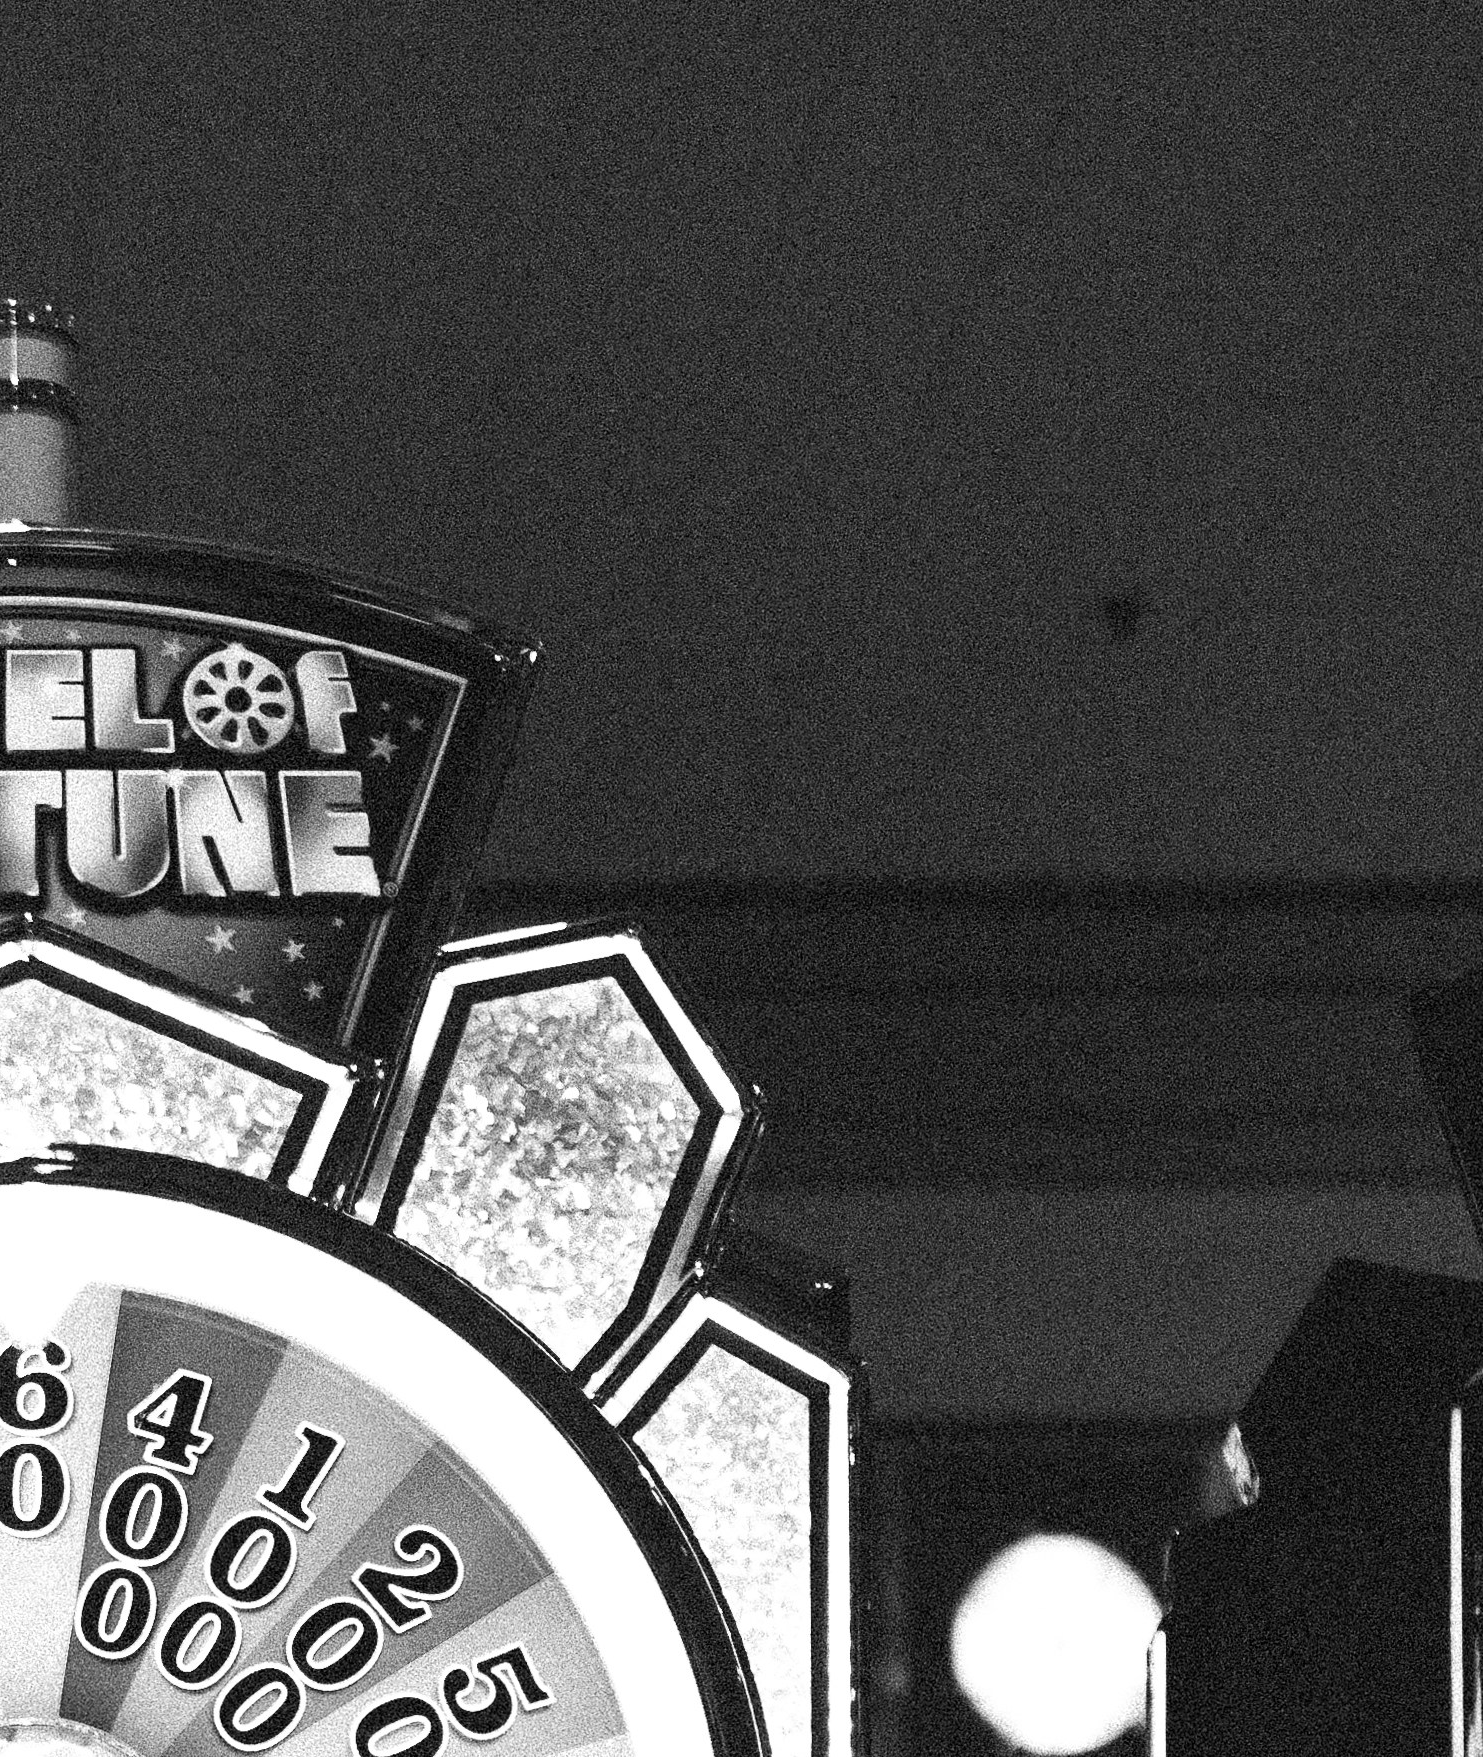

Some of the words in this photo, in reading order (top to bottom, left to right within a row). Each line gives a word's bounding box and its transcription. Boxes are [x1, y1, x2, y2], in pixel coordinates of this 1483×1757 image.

[75, 1368, 213, 1659] 400
[154, 1423, 345, 1691] 100
[213, 1524, 464, 1752] 200
